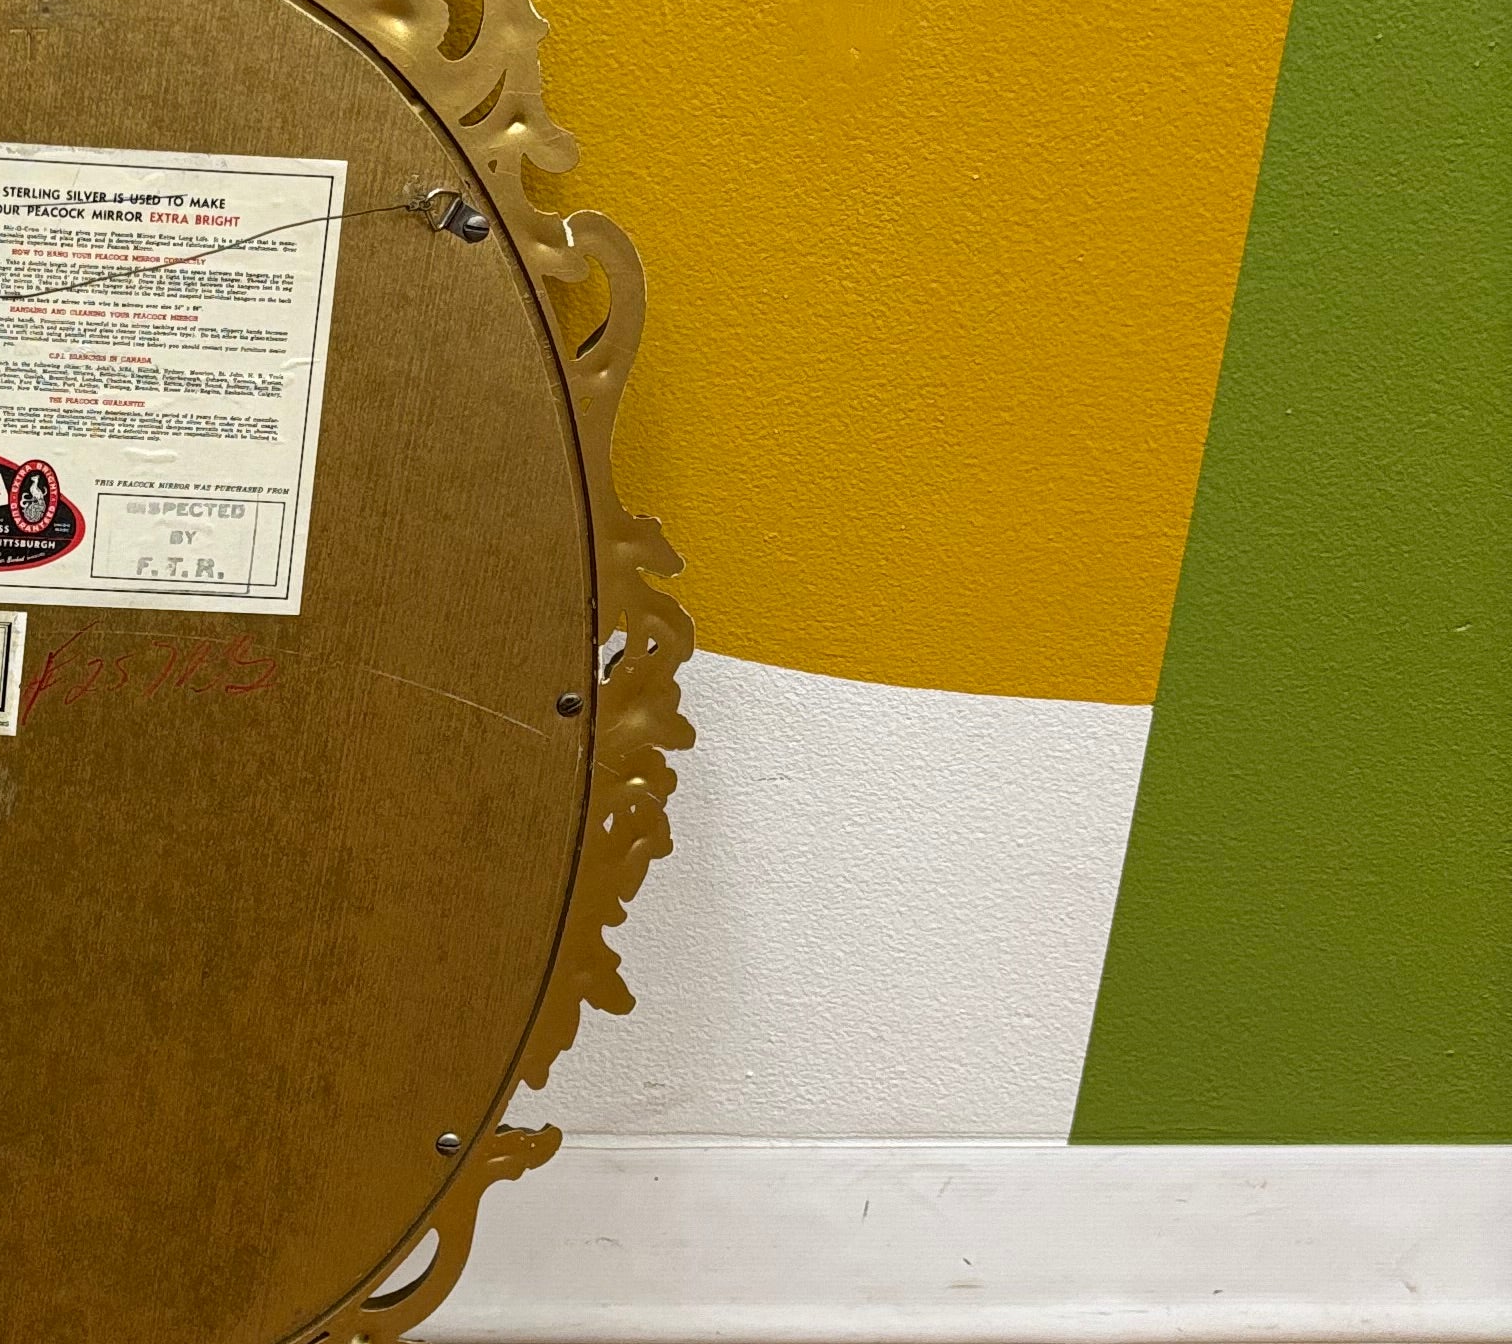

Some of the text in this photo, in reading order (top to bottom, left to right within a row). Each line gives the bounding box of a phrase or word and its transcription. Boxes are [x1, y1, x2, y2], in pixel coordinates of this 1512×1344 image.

[3, 187, 226, 209] STERLING SILVER IS USED TO MAKE
[27, 205, 85, 219] PEACOCK
[92, 209, 143, 222] MIRROR
[150, 212, 189, 224] EXTRA
[195, 214, 240, 227] BRIGHT
[33, 249, 44, 257] TO
[12, 462, 59, 494] EXTRA BRIGHT
[95, 479, 114, 487] THIS
[117, 480, 155, 488] PEACOCK
[158, 482, 190, 490] MIRROR
[214, 485, 264, 493] PURCHASED
[267, 487, 290, 495] FROM
[10, 502, 57, 533] GUARANTEED
[170, 530, 197, 545] BY
